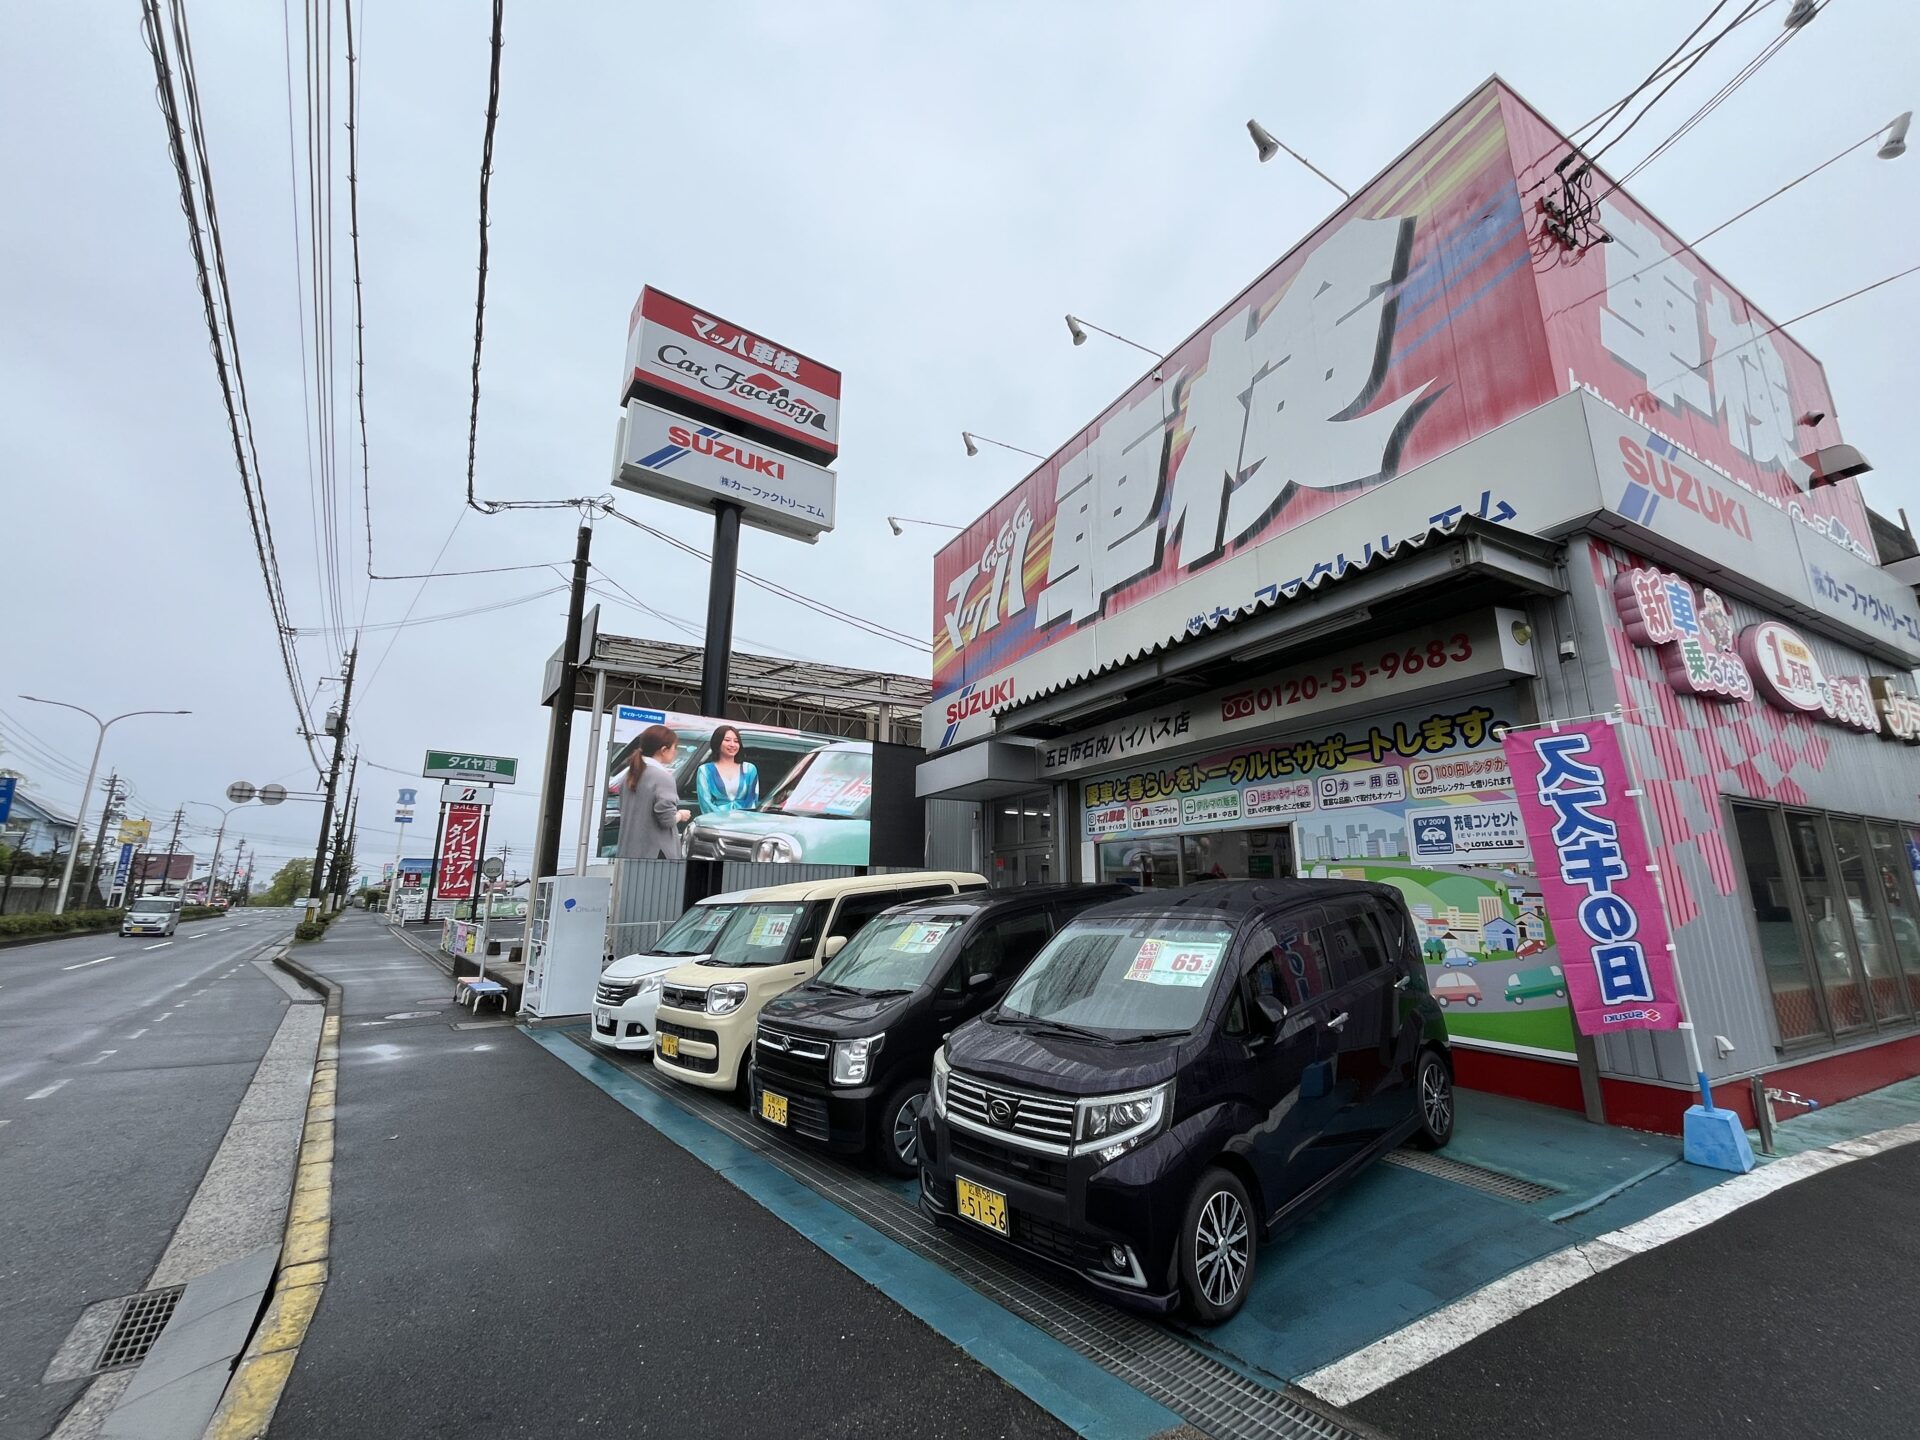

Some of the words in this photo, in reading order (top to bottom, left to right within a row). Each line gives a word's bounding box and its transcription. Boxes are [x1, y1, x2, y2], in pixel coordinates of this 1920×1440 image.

[657, 344, 708, 376] Car
[701, 363, 814, 424] Factory
[668, 425, 786, 481] SUZUKI
[1618, 435, 1753, 542] SUZUKI
[1636, 577, 1698, 637] 新車
[1257, 632, 1473, 712] 0120-55-9683
[1683, 641, 1749, 693] 乗るなら
[946, 678, 1015, 724] SUZUKI
[448, 756, 497, 772] タイヤ館
[1045, 710, 1191, 768] 五日市石内バイパス店
[1338, 771, 1399, 792] カー用品
[1429, 818, 1446, 826] 200V
[1453, 810, 1519, 832] 充電コンセント
[1471, 840, 1494, 848] LOTAS
[1495, 839, 1514, 847] CLUB
[441, 823, 463, 891] タイヤセール
[454, 815, 480, 889] プレミアム
[967, 1196, 1007, 1232] 51-56
